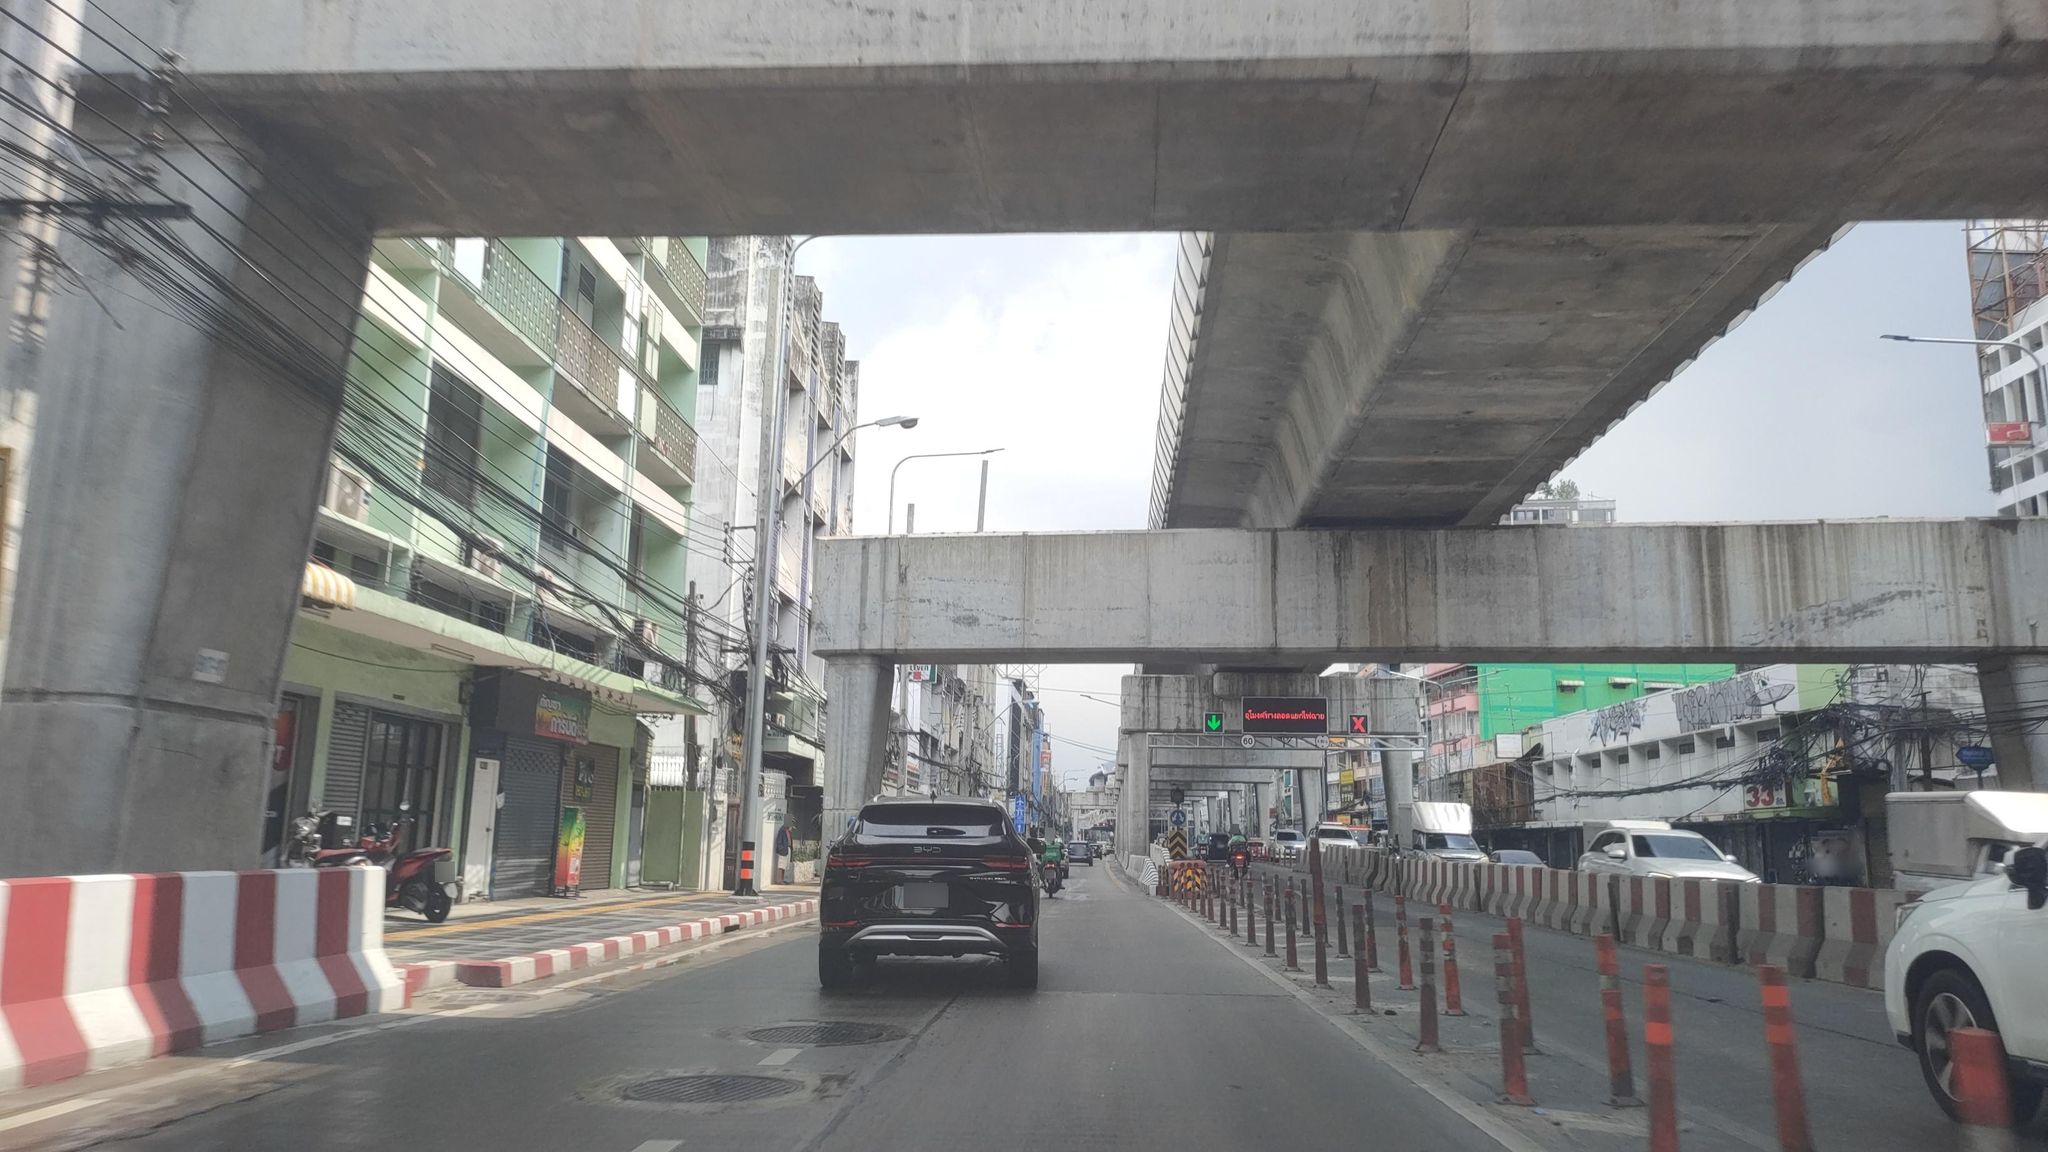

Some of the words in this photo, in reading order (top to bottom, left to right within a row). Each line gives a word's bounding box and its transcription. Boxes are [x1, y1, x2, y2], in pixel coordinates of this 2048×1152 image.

[1243, 737, 1253, 745] 60
[1746, 784, 1775, 807] 33
[913, 846, 942, 854] BYD
